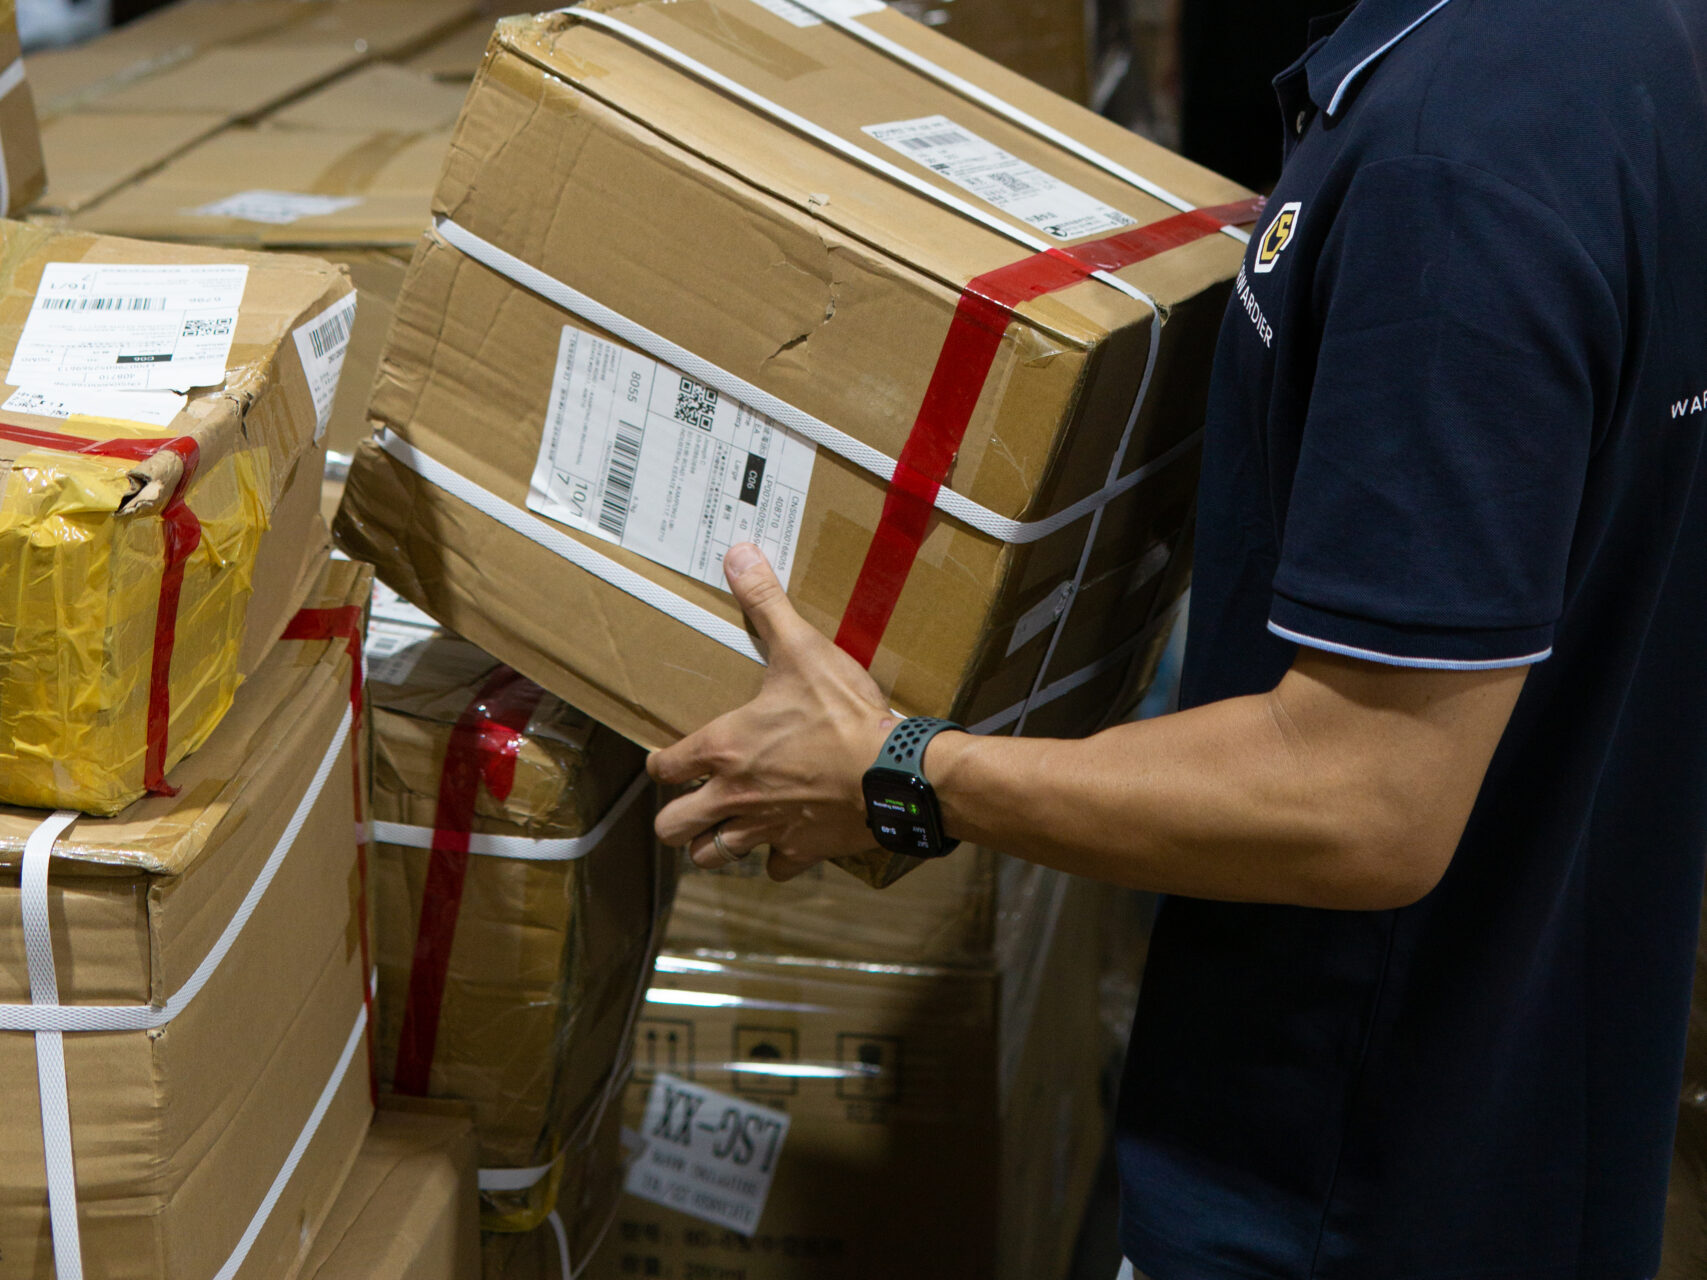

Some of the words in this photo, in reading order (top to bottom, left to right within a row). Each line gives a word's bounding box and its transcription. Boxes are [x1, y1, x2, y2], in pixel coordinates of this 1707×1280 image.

[1235, 258, 1274, 349] WARDIER
[626, 371, 641, 403] 8055
[556, 472, 570, 485] 7
[731, 459, 741, 481] Large
[746, 470, 757, 490] C06
[570, 481, 589, 518] 10/1
[771, 496, 784, 529] 408710
